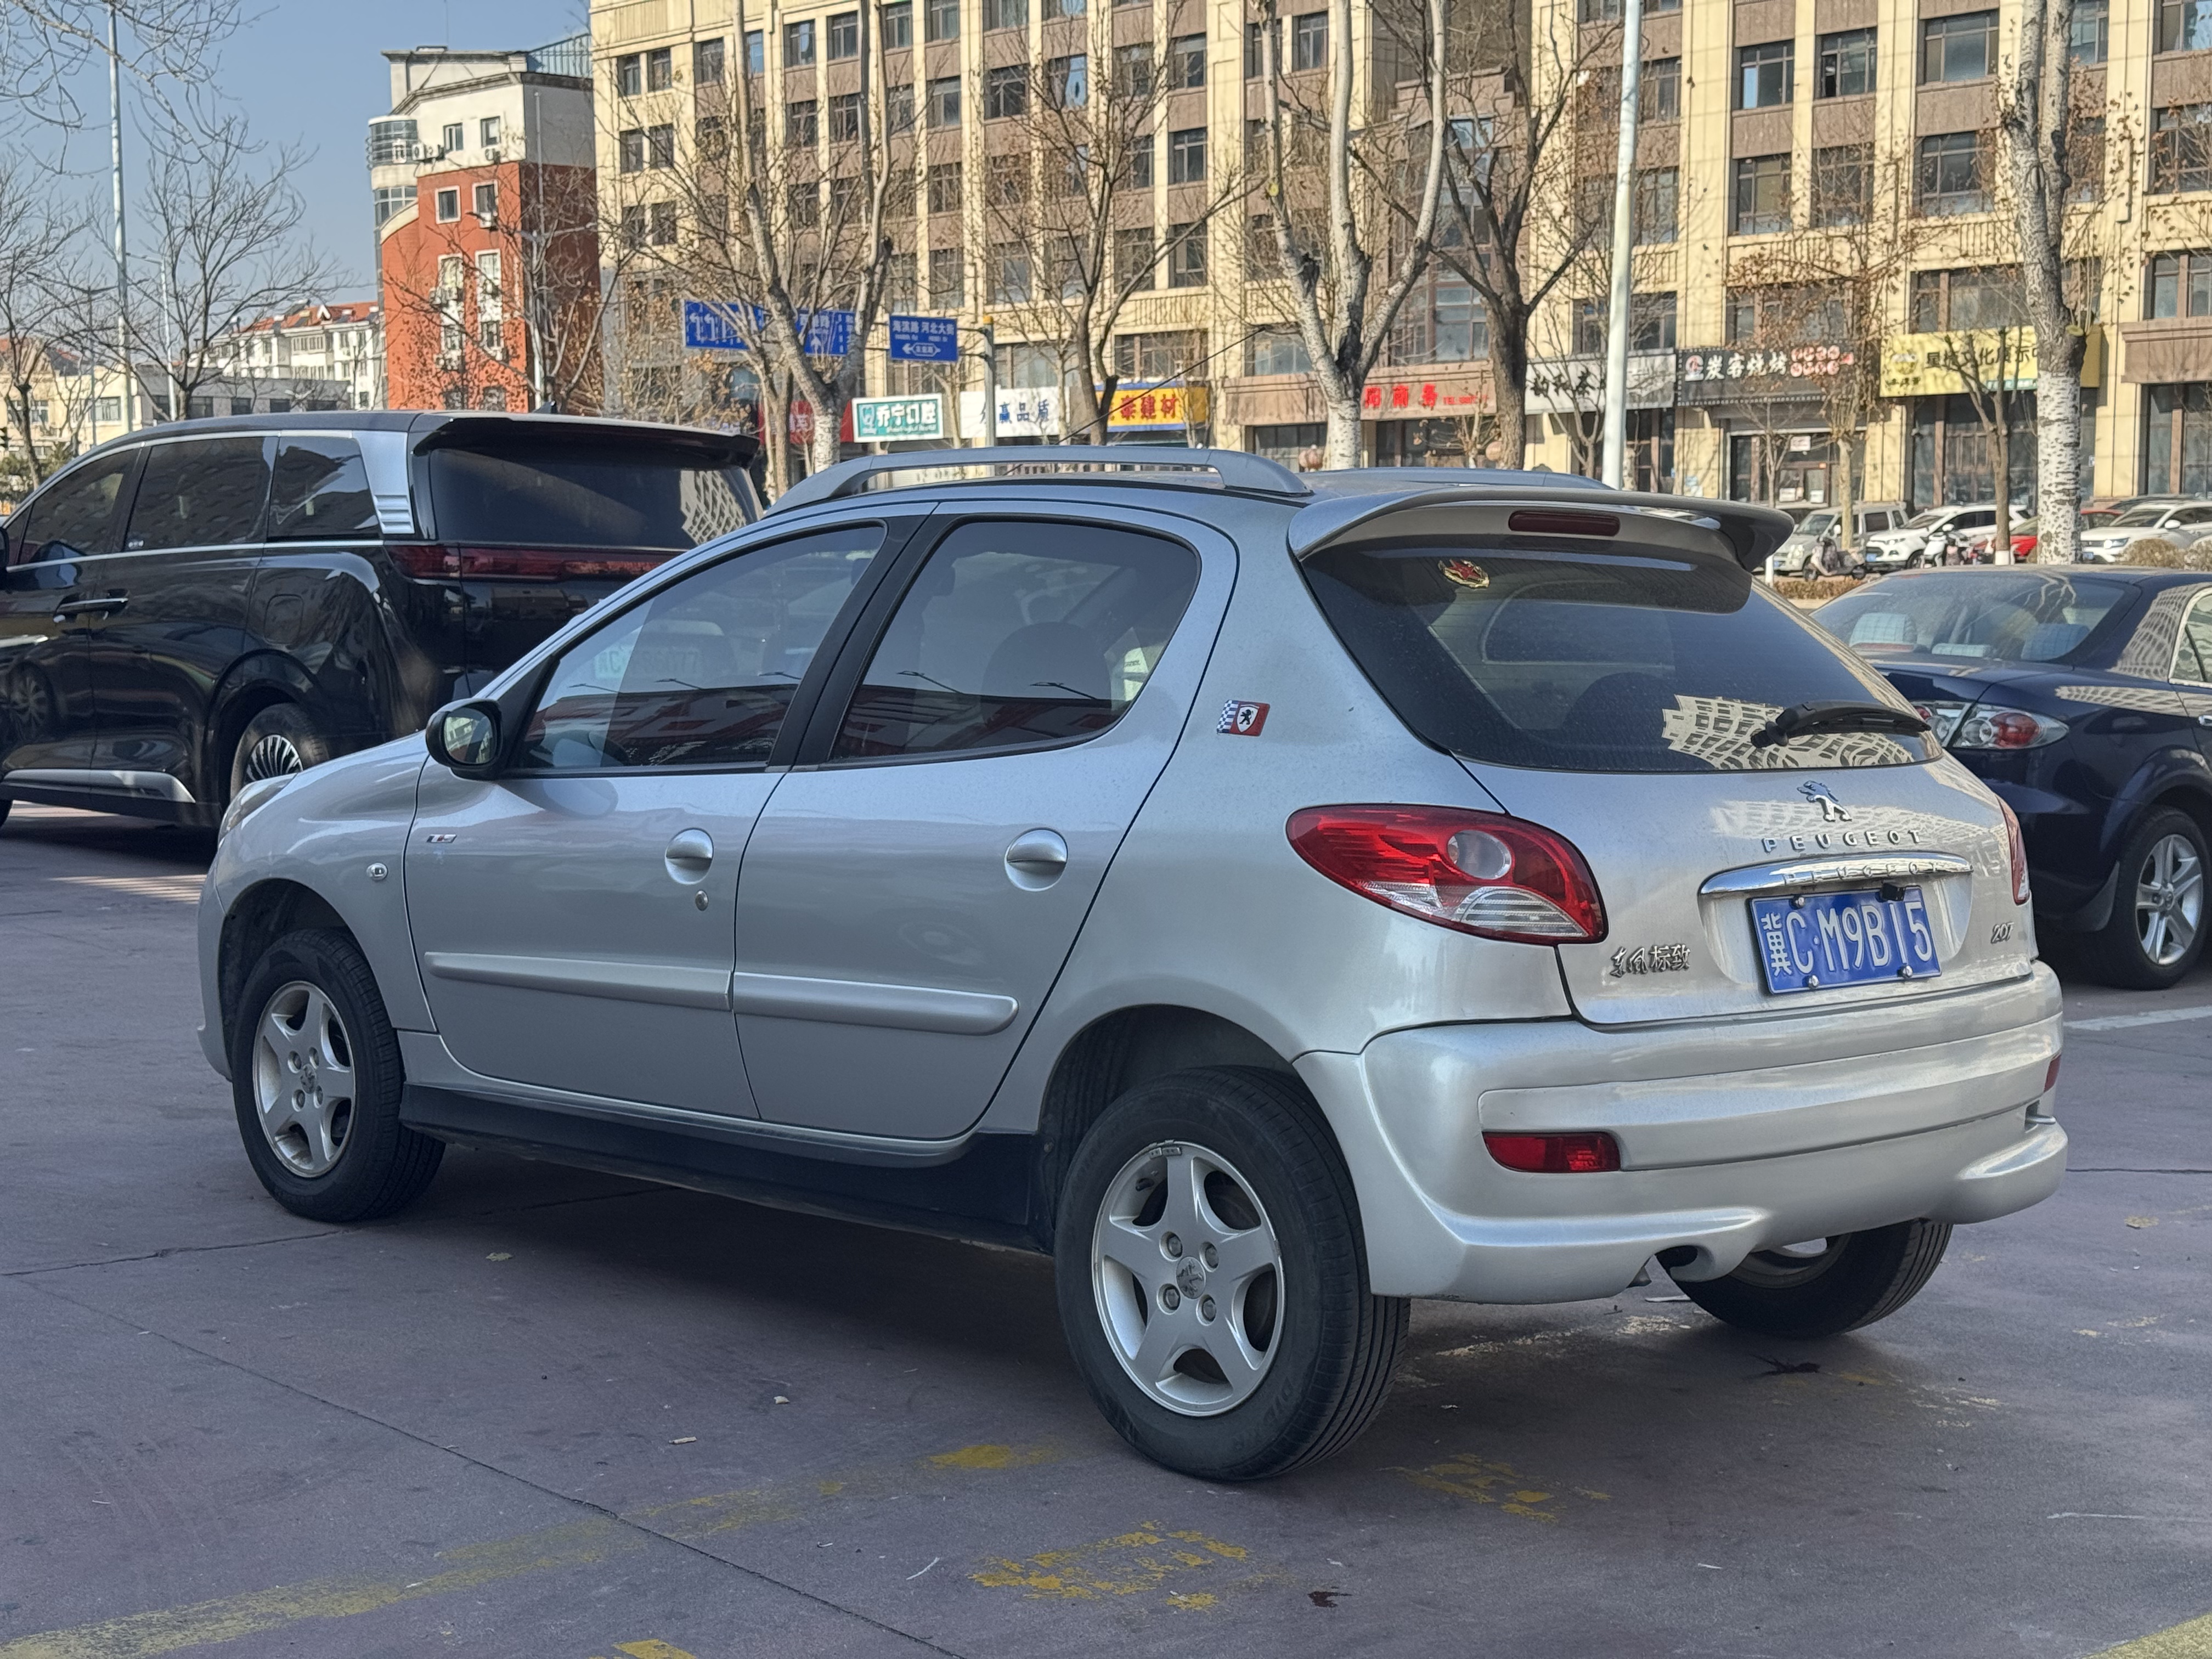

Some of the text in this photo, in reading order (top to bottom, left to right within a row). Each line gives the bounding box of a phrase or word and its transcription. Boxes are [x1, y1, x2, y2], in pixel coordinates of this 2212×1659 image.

[921, 321, 955, 335] 河北大街
[1762, 829, 1921, 854] PEUGEOT
[1990, 921, 2015, 944] 207
[1610, 943, 1691, 978] 东风标致
